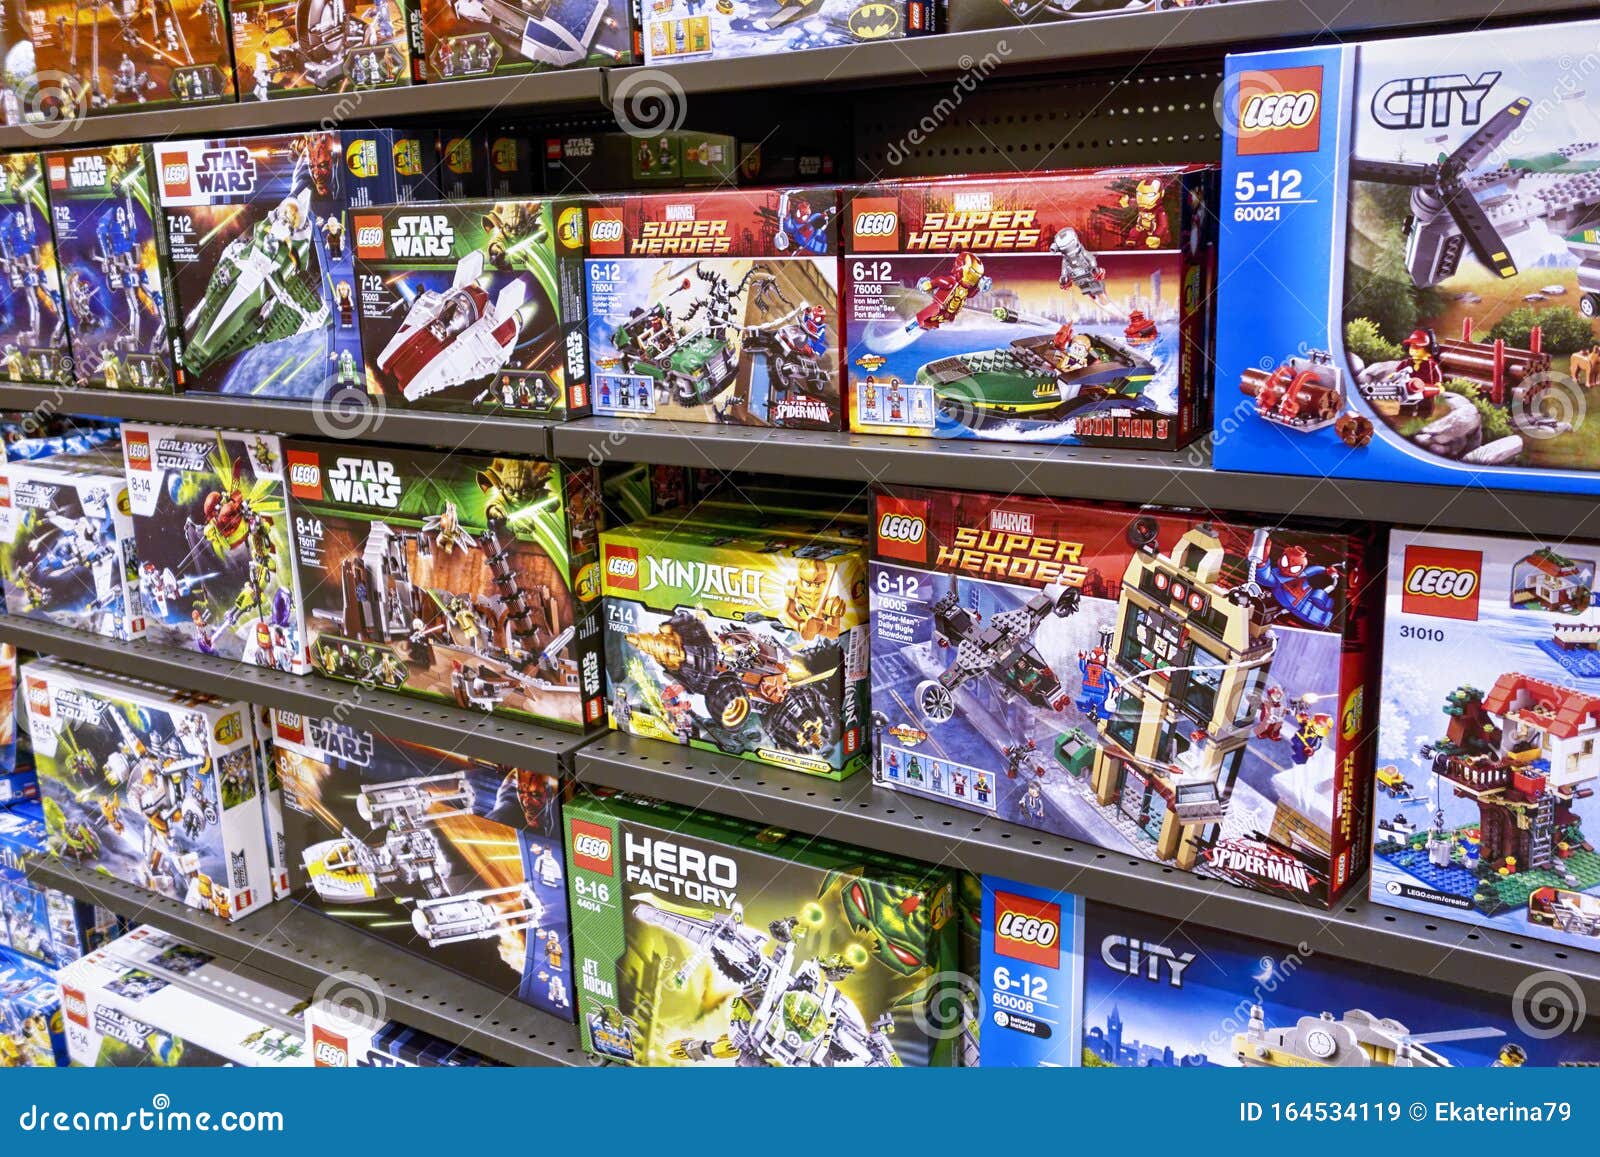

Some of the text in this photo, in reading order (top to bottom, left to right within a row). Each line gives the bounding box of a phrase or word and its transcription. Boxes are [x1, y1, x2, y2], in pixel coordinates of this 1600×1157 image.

[1243, 93, 1317, 129] LEGO
[564, 138, 594, 148] STAR
[564, 146, 594, 156] WARS
[69, 156, 106, 172] STAR
[196, 149, 256, 173] STAR
[69, 171, 107, 187] WARS
[164, 164, 190, 184] LEGO
[197, 171, 256, 194] WARS
[1235, 169, 1302, 200] 5-12
[167, 215, 192, 232] 7-12
[665, 205, 695, 221] MARVEL
[923, 209, 1037, 231] SUPER
[1234, 207, 1280, 222] 60021
[391, 215, 454, 237] STAR
[590, 220, 622, 241] LEGO
[641, 219, 728, 238] SUPER
[855, 213, 896, 236] LEGO
[357, 228, 383, 246] LEGO
[391, 235, 454, 257] WARS
[630, 237, 732, 254] HEROES
[907, 229, 1041, 250] HEROES
[591, 264, 620, 280] 6-12
[853, 262, 892, 280] 6-12
[360, 275, 382, 290] 7-12
[592, 283, 613, 292] 76004
[854, 284, 882, 294] 76006
[567, 331, 577, 379] STAR
[574, 331, 585, 379] WARS
[775, 404, 831, 424] SPIDER-MAN
[1117, 418, 1153, 439] MAN
[1156, 419, 1168, 440] 3
[129, 443, 149, 459] LEGO
[159, 439, 208, 454] GALAXY
[158, 455, 205, 472] SQUAD
[328, 457, 400, 485] STAR
[131, 477, 151, 492] 8-14
[291, 464, 320, 486] LEGO
[329, 478, 402, 509] WARS
[296, 517, 323, 537] 8-14
[880, 515, 925, 542] LEGO
[991, 509, 1035, 536] MARVEL
[954, 527, 1085, 564] SUPER
[608, 557, 637, 578] LEGO
[936, 545, 1088, 588] HEROES
[644, 555, 770, 609] NINJAGO
[877, 571, 918, 598] 6-12
[1408, 567, 1476, 598] LEGO
[608, 605, 634, 624] 7-14
[877, 596, 907, 612] 76005
[878, 620, 914, 635] Daily Bugle
[878, 627, 913, 642] Showdown
[1400, 625, 1444, 642] 31010
[279, 709, 300, 729] LEGO
[575, 835, 610, 860] LEGO
[625, 832, 737, 889] HERO
[1208, 847, 1310, 894] SPIDER-MAN
[575, 876, 609, 901] 8-16
[626, 865, 737, 910] FACTORY
[1406, 887, 1470, 908] LEGO.com/creator
[577, 897, 601, 913] 44014
[999, 913, 1056, 946] LEGO
[583, 957, 599, 978] JET
[583, 973, 614, 999] ROCKA
[994, 966, 1048, 1002] 6-12
[993, 992, 1034, 1014] 60008
[97, 1005, 148, 1035] GALAXY
[96, 1020, 145, 1049] SQUAD
[317, 1041, 347, 1067] LEGO
